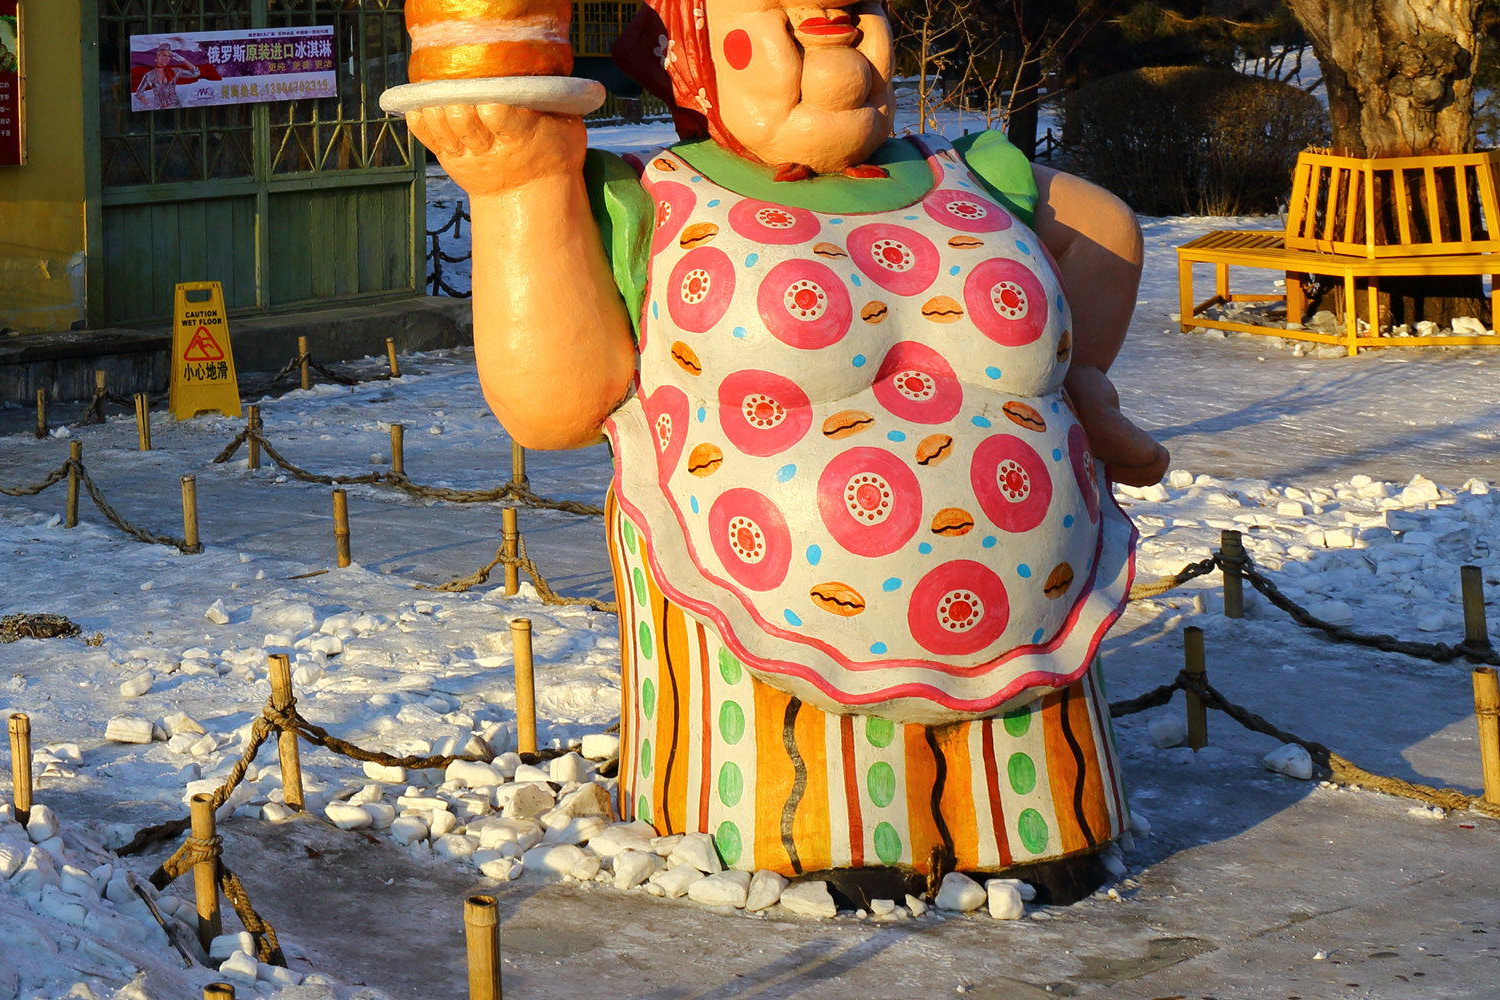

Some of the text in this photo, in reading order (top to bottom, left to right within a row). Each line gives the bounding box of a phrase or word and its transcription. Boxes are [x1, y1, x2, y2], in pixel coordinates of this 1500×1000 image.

[207, 39, 333, 64] 俄罗斯原装进口冰淇淋
[185, 310, 217, 318] CAUTION
[199, 318, 222, 326] FLOOR
[184, 361, 228, 381] 小心地滑
